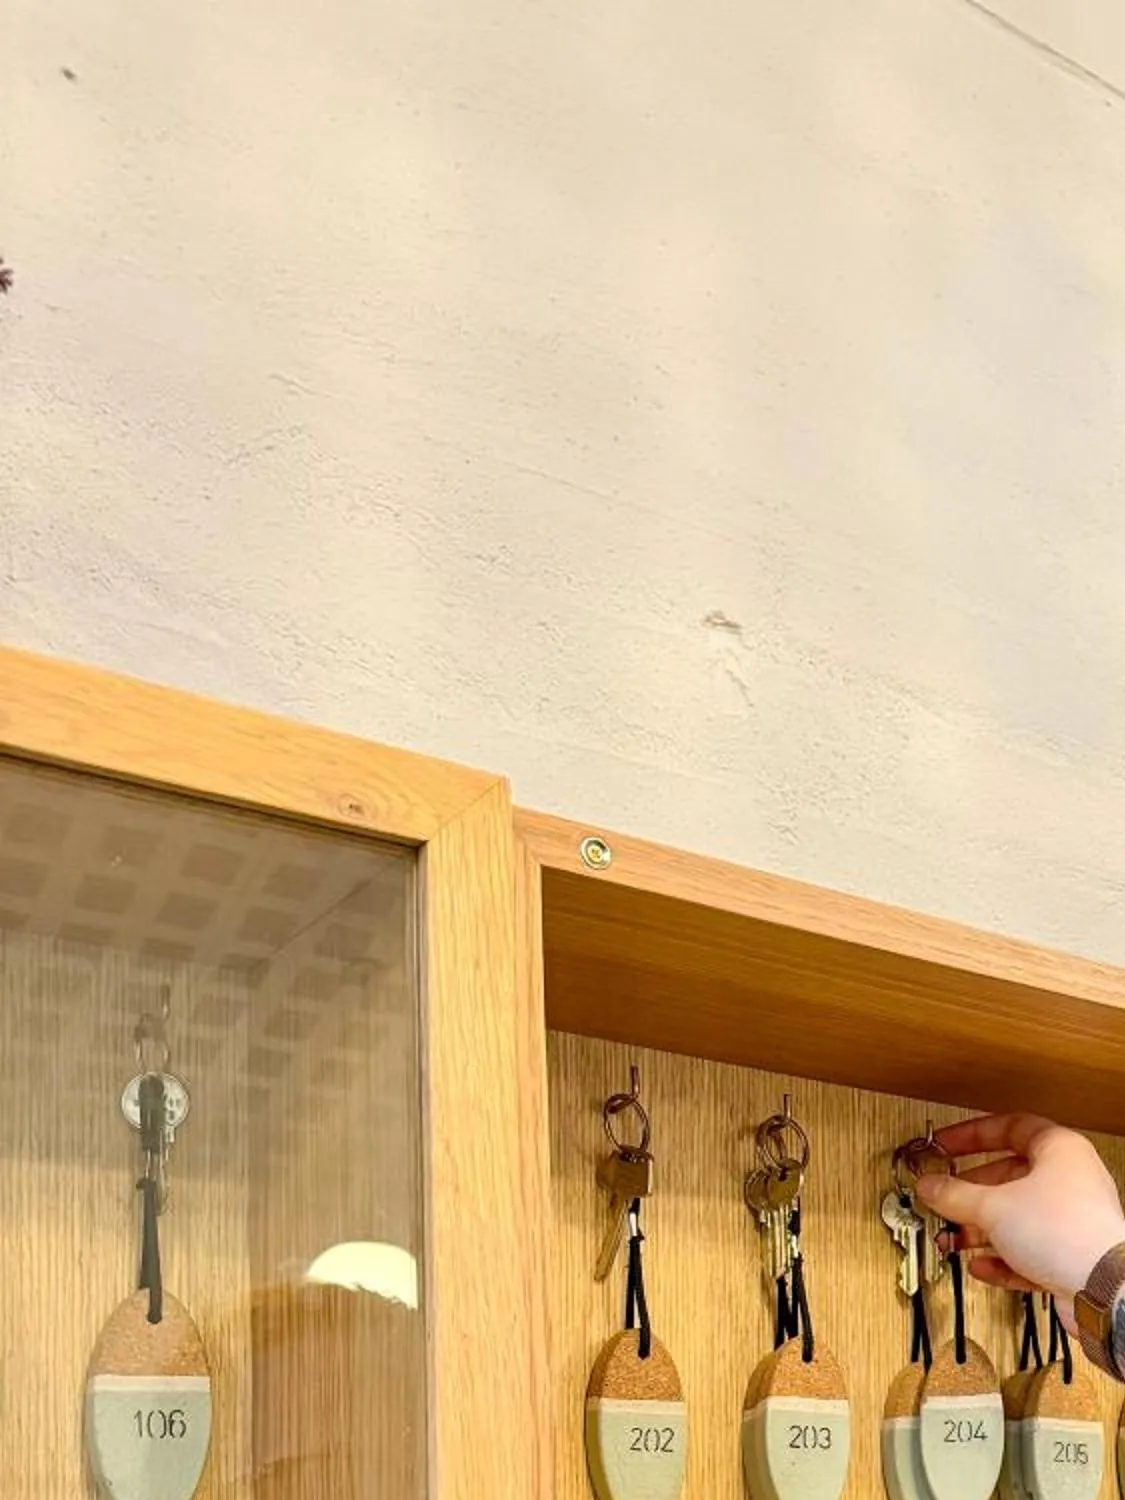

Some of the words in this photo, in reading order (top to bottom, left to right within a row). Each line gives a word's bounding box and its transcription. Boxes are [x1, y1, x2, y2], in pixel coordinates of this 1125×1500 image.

[133, 1408, 187, 1440] 106
[789, 1424, 832, 1450] 203
[943, 1419, 988, 1444] 204
[630, 1426, 675, 1453] 202
[1053, 1441, 1089, 1465] 205
